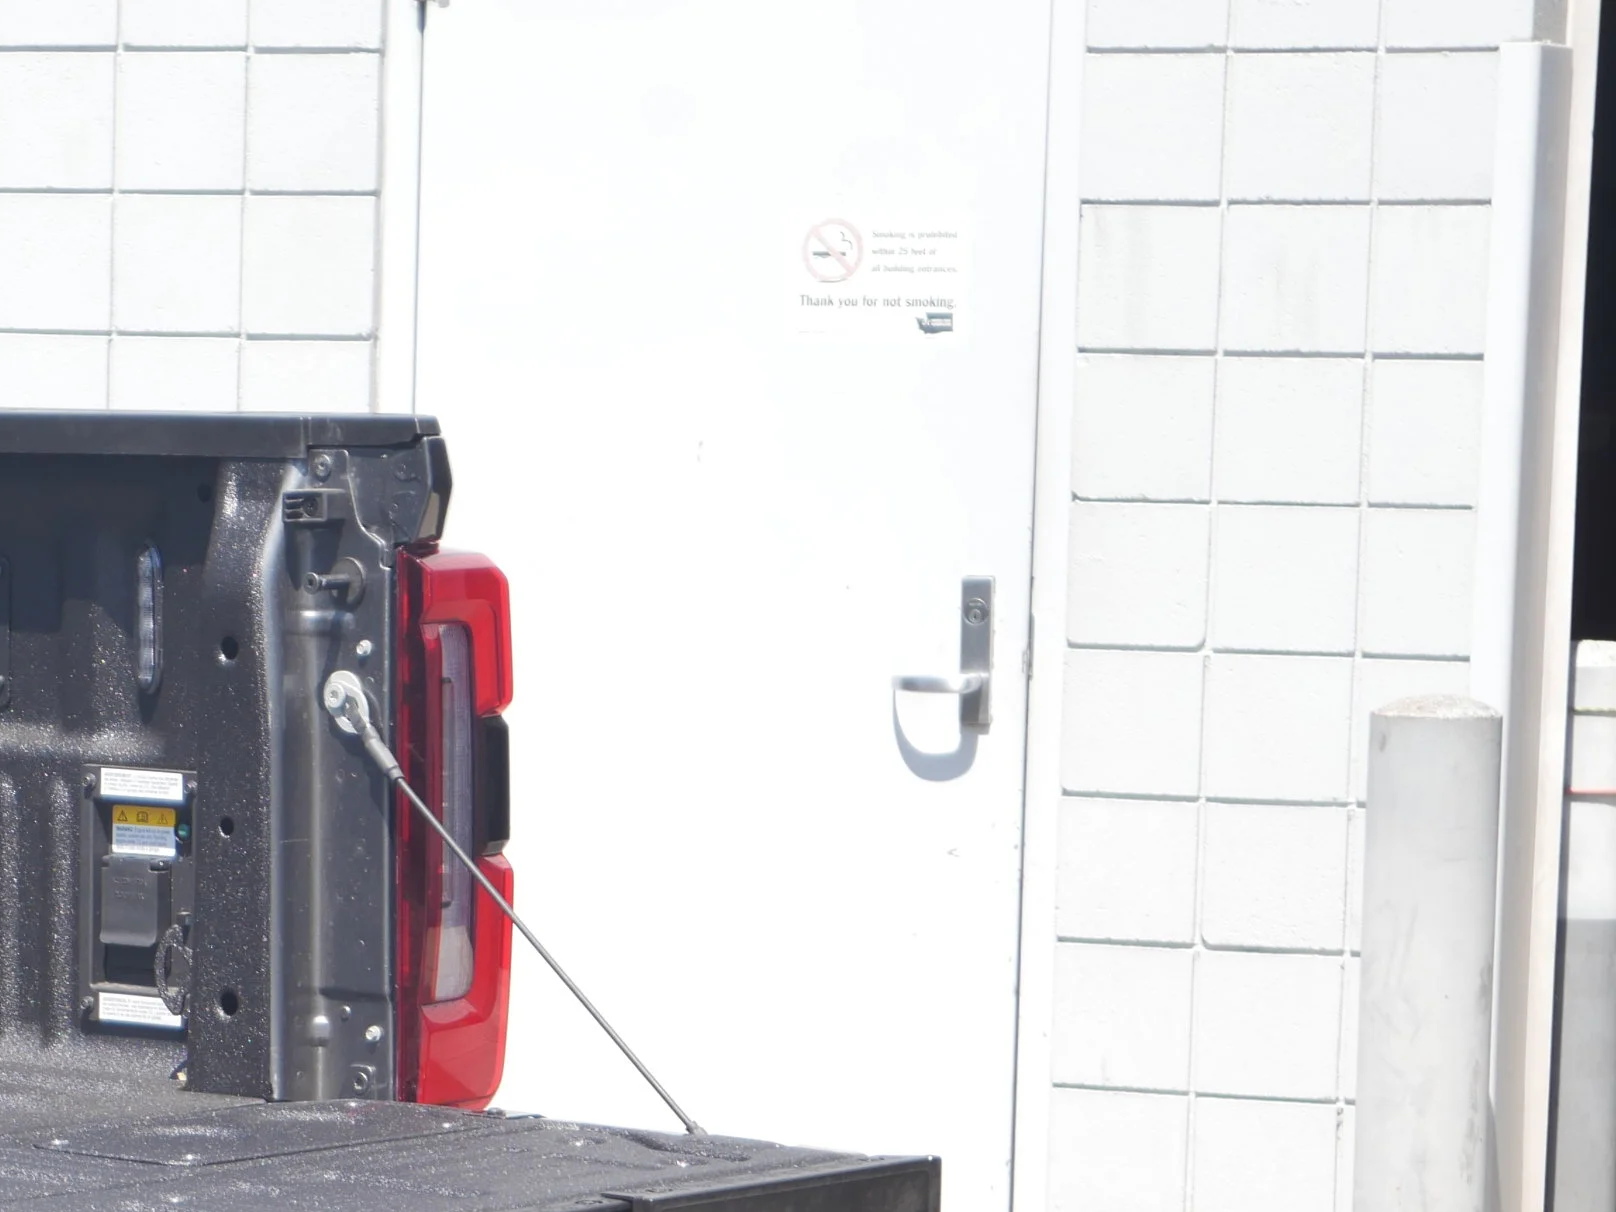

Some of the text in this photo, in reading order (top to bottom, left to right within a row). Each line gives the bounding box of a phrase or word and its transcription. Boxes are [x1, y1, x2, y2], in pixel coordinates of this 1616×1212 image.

[898, 247, 909, 255] 25
[799, 294, 957, 309] Thank you for not smoking.
